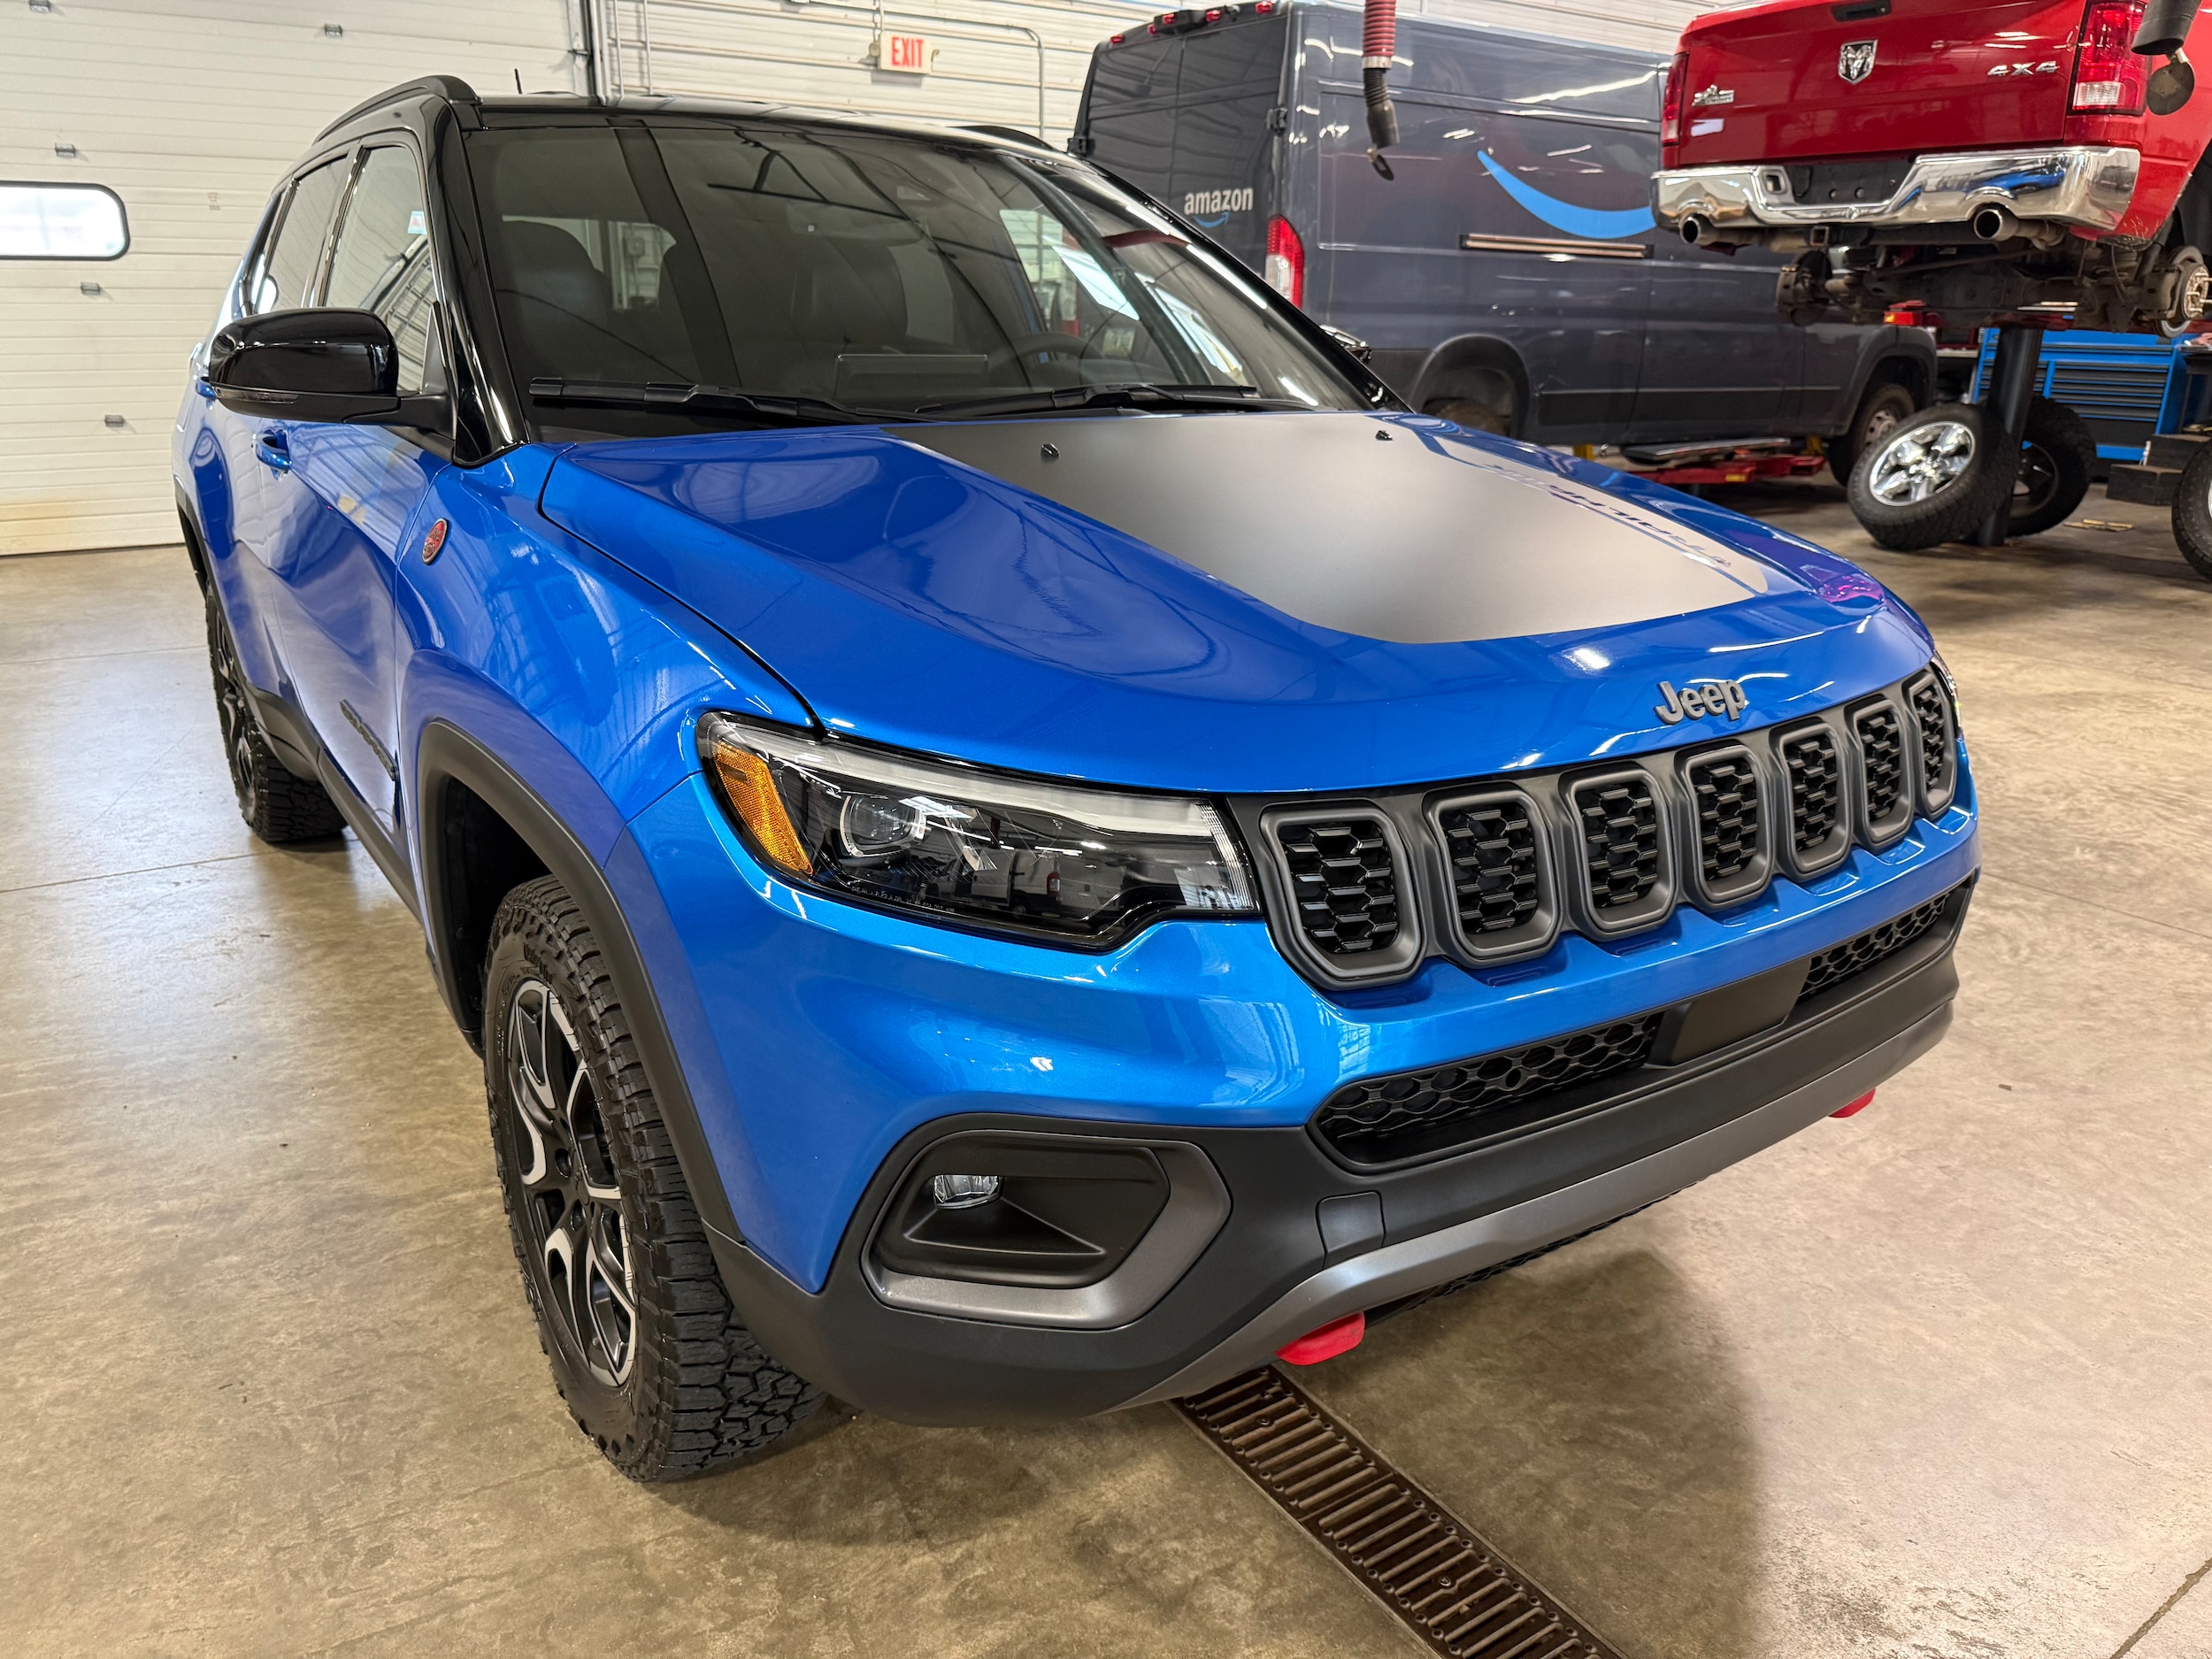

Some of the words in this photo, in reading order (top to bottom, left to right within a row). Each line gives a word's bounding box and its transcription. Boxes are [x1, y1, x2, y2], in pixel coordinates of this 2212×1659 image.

[892, 36, 924, 68] EXIT
[1184, 187, 1254, 215] amazon
[1655, 680, 1747, 726] Jeep
